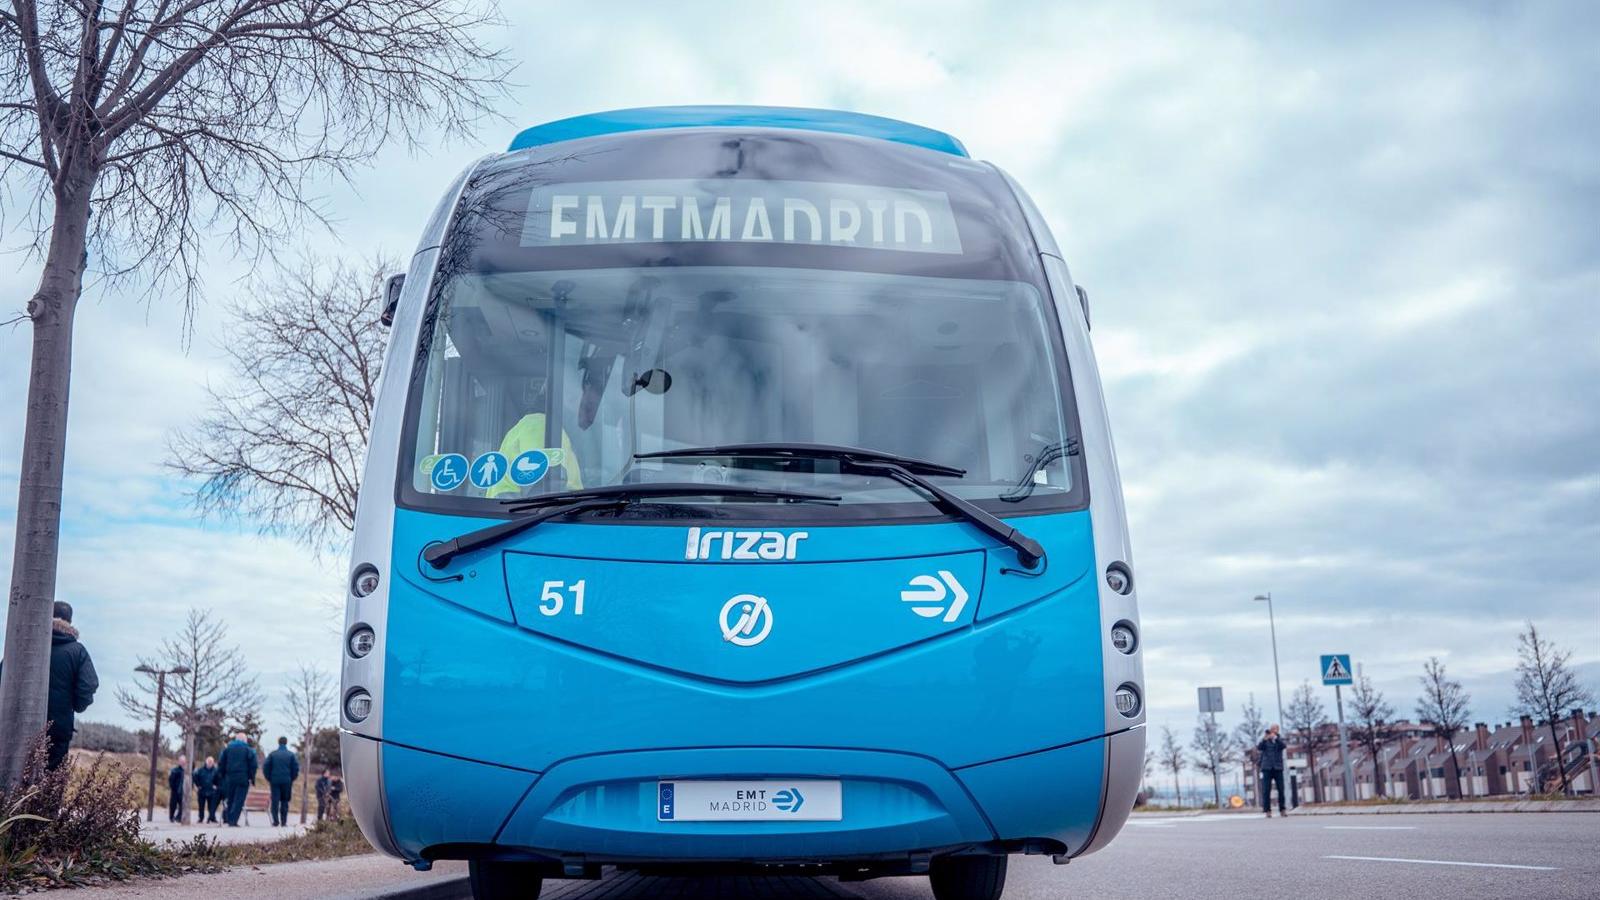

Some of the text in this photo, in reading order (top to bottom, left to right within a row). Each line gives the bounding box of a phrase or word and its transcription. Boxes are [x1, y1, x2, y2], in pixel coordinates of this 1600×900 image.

[684, 526, 809, 561] Irizar
[538, 579, 586, 617] 51
[736, 790, 767, 800] EMT
[663, 805, 671, 814] E
[710, 801, 767, 812] MADRID
